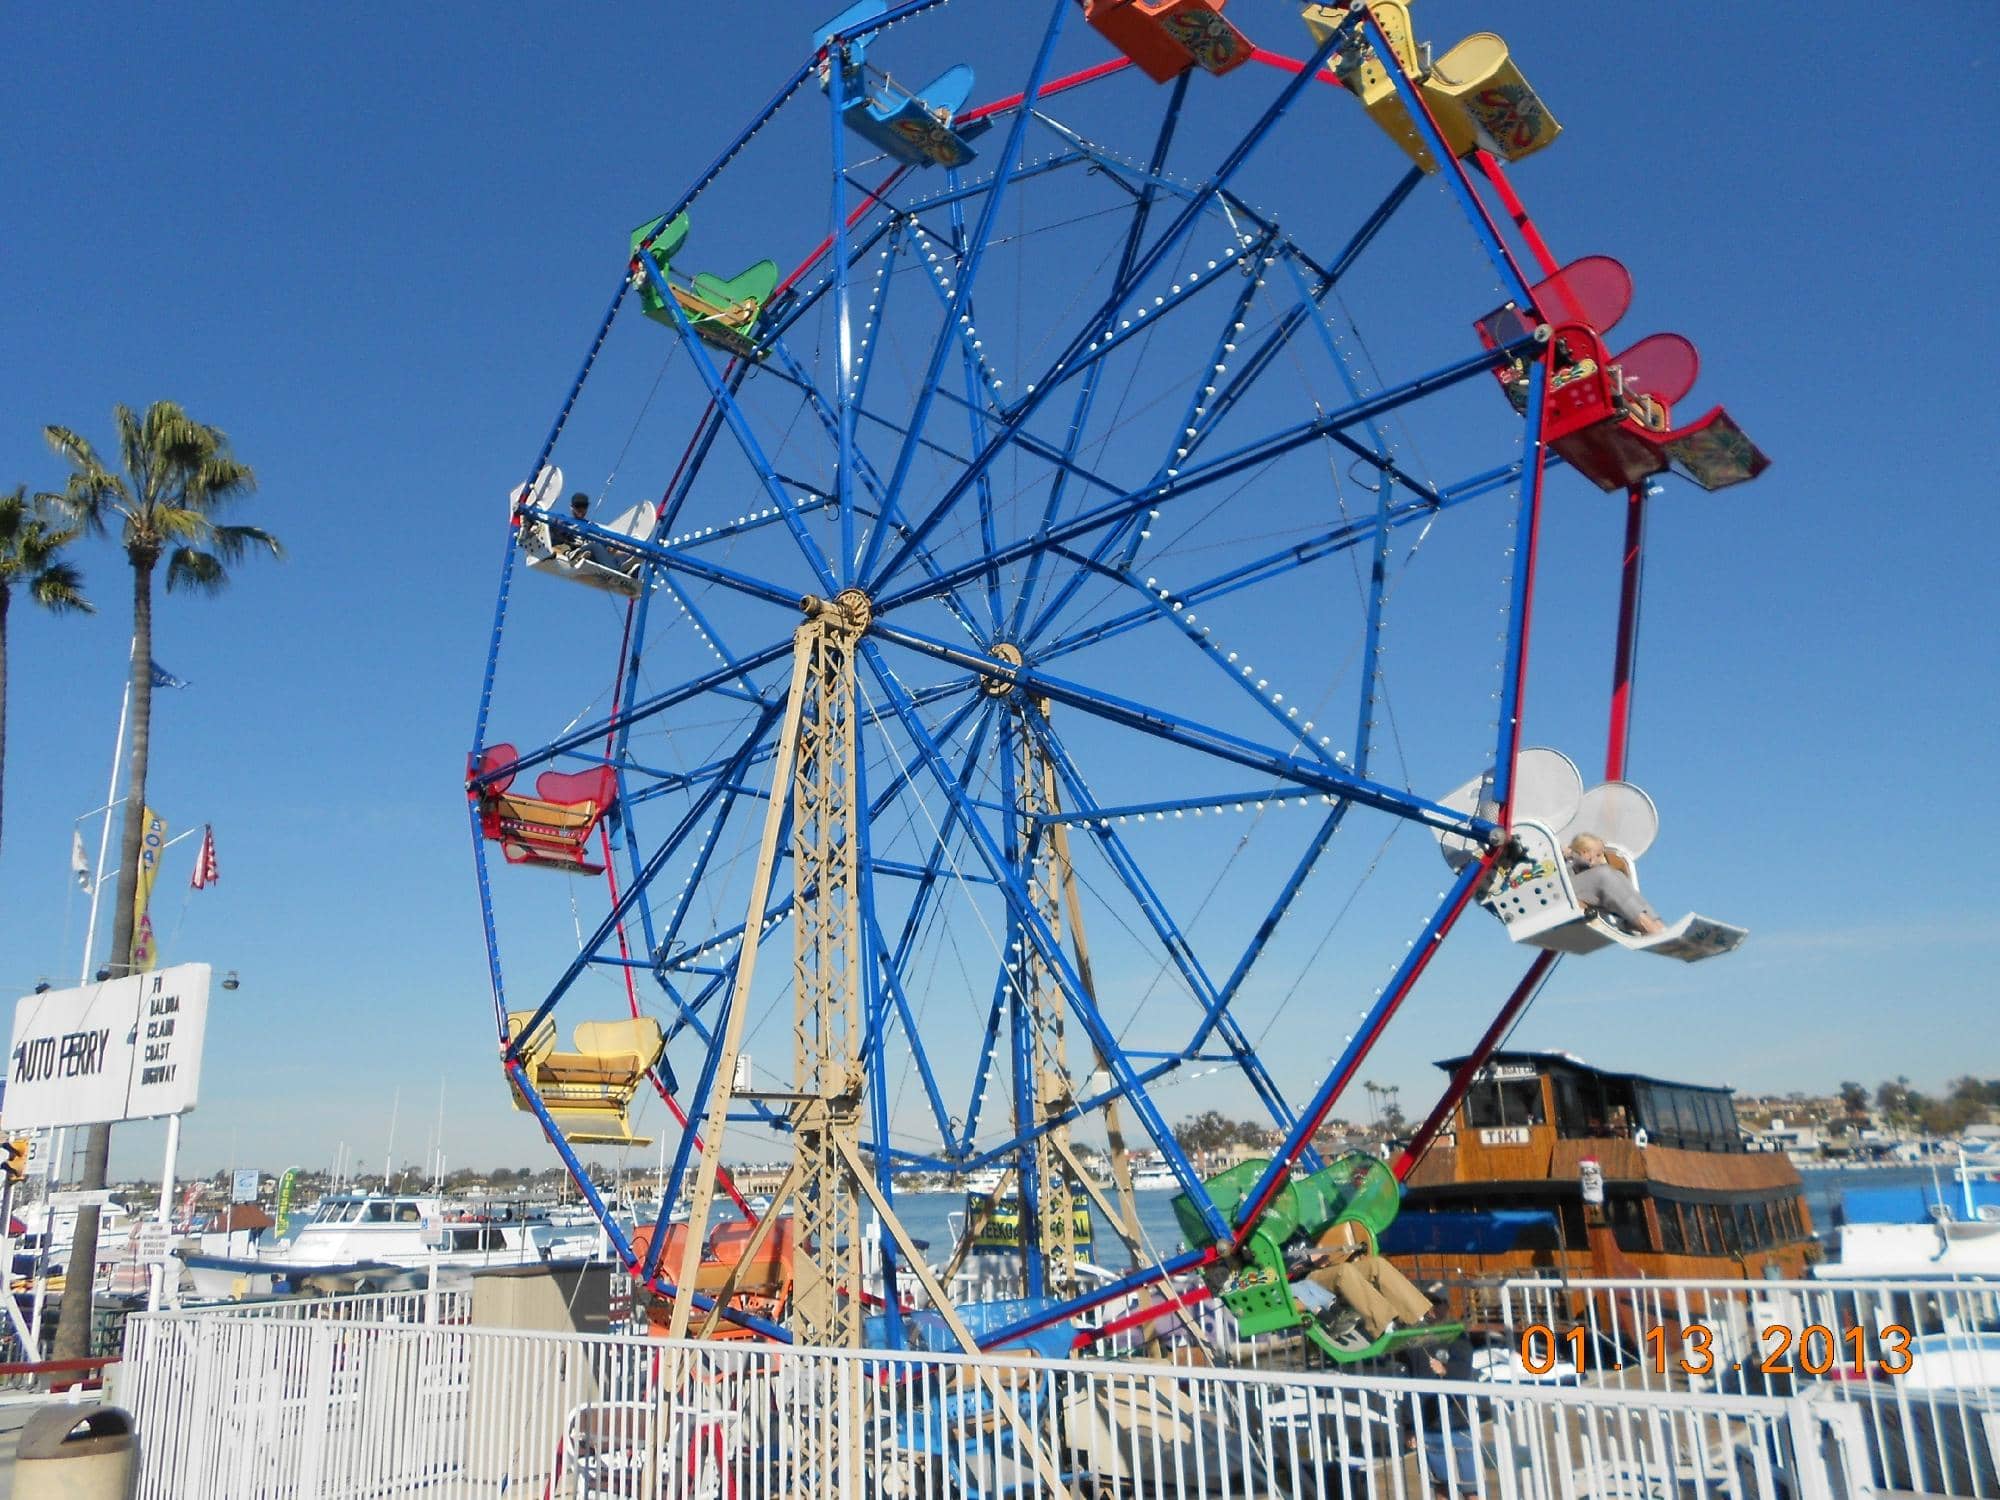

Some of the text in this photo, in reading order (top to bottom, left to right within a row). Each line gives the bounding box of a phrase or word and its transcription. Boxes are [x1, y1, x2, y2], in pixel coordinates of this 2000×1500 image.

[150, 996, 180, 1017] BALBOA
[15, 1028, 110, 1084] AUTO FERRY
[145, 1042, 170, 1062] COAST
[1487, 1130, 1520, 1143] TIKI
